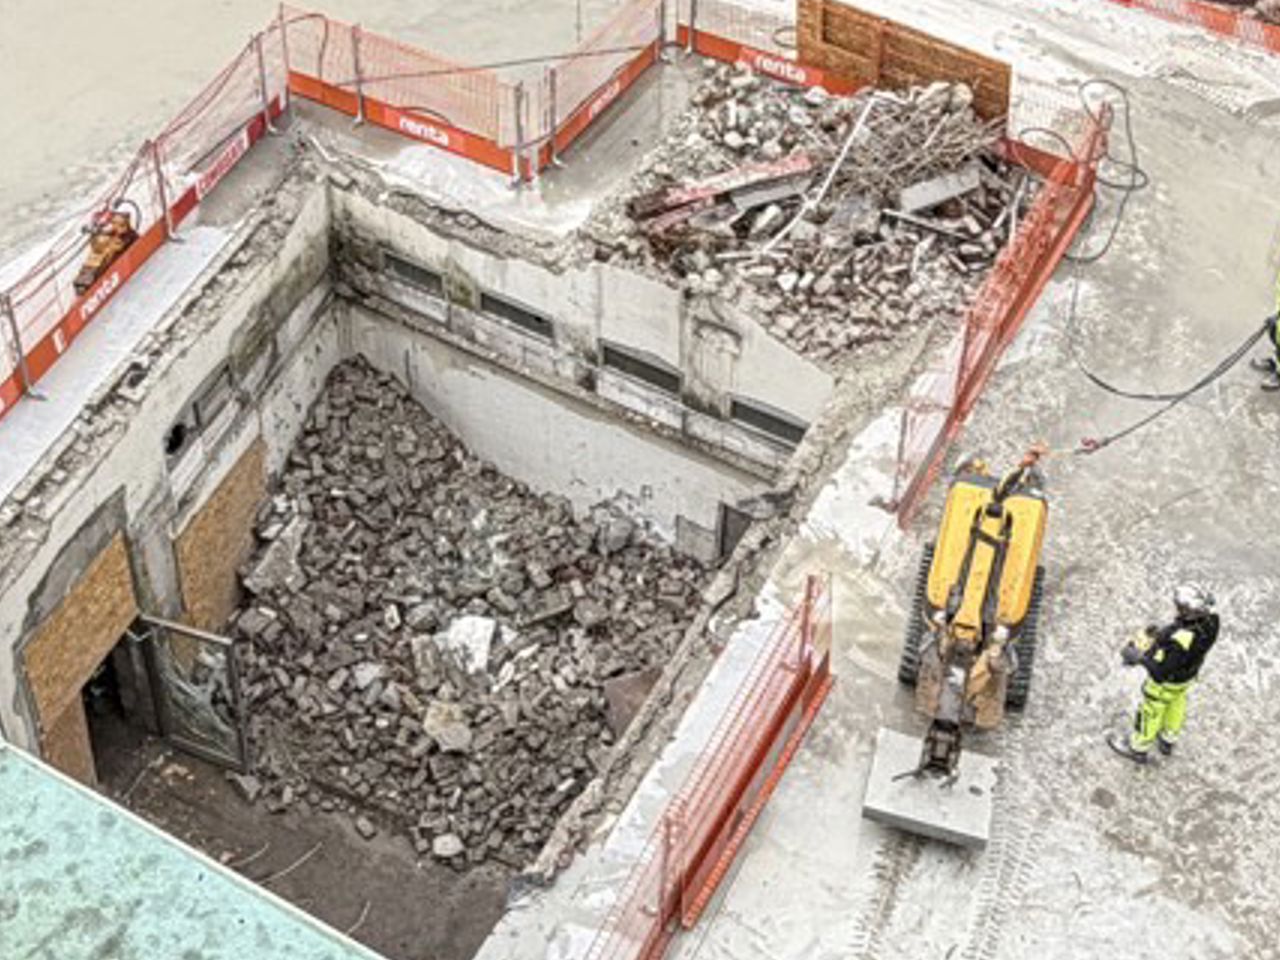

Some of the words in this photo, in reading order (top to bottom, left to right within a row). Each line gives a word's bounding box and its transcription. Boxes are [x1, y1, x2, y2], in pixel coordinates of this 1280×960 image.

[754, 54, 806, 83] renta
[400, 116, 449, 146] renta
[81, 271, 119, 321] renta
